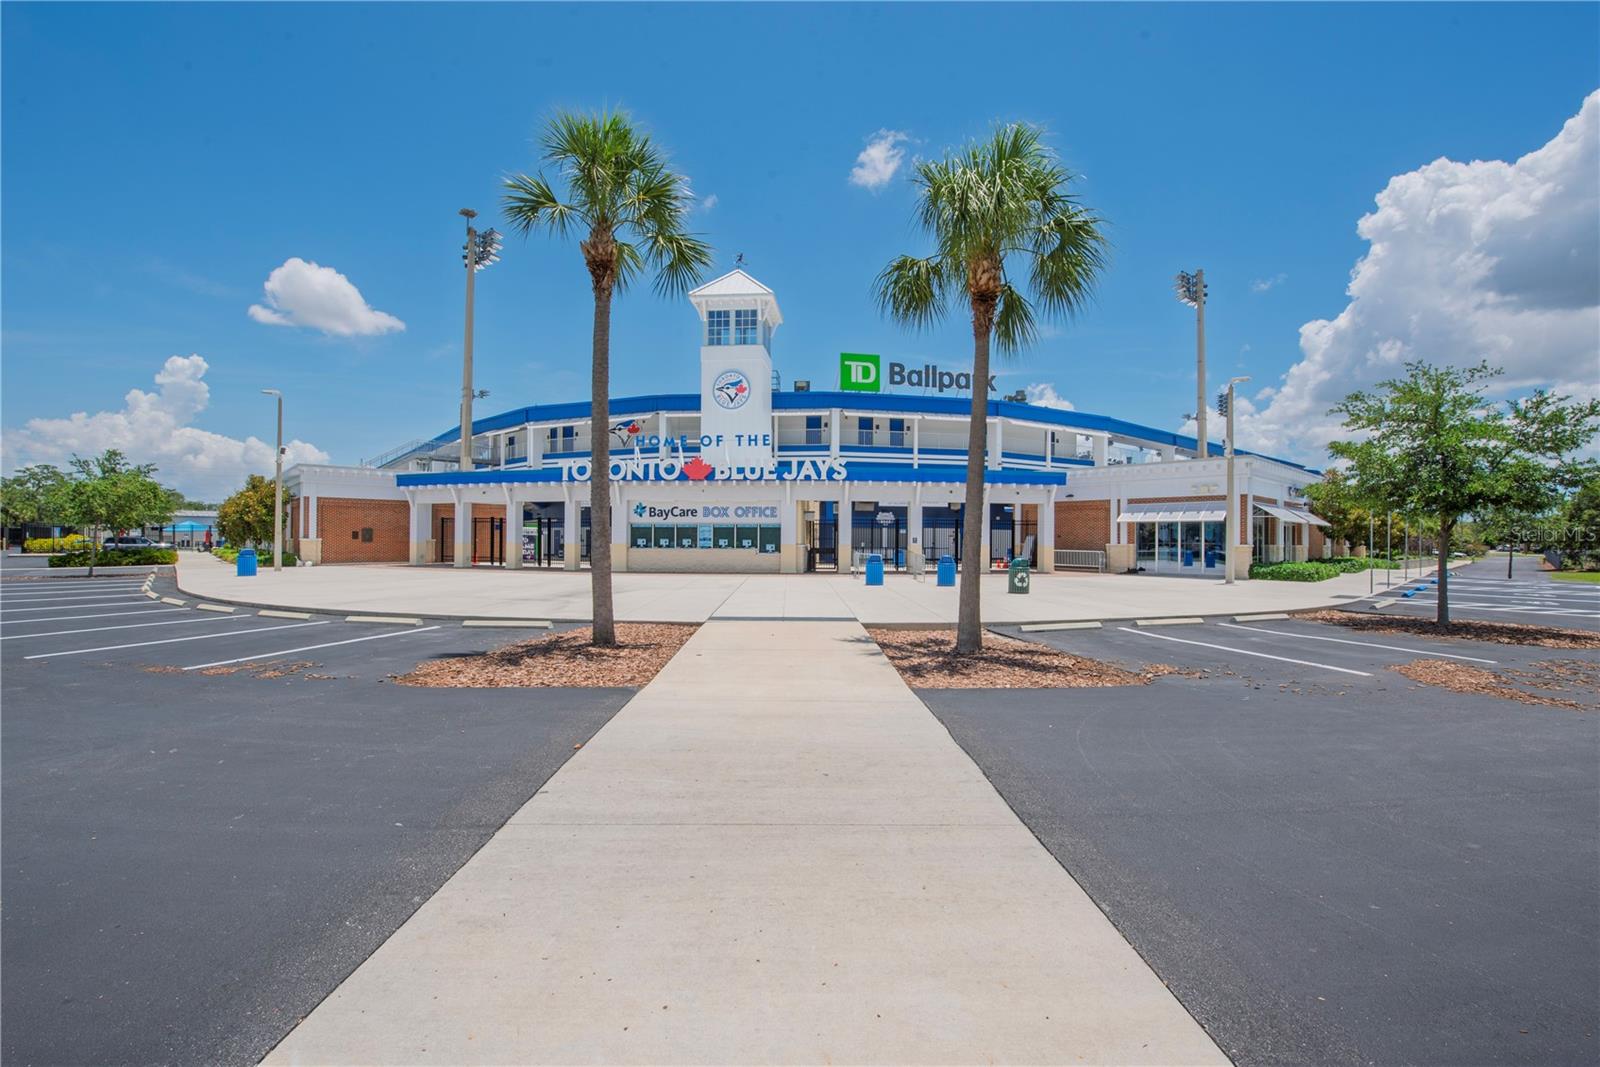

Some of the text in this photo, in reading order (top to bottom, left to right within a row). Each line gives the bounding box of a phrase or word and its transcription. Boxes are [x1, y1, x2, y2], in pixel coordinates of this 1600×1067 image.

[844, 361, 877, 384] TD
[888, 362, 997, 393] Ballpak
[635, 434, 771, 447] HOME OF THE
[558, 457, 848, 482] TOONTO BLUE JAYS
[649, 506, 778, 521] BayCare BOX OFFICE
